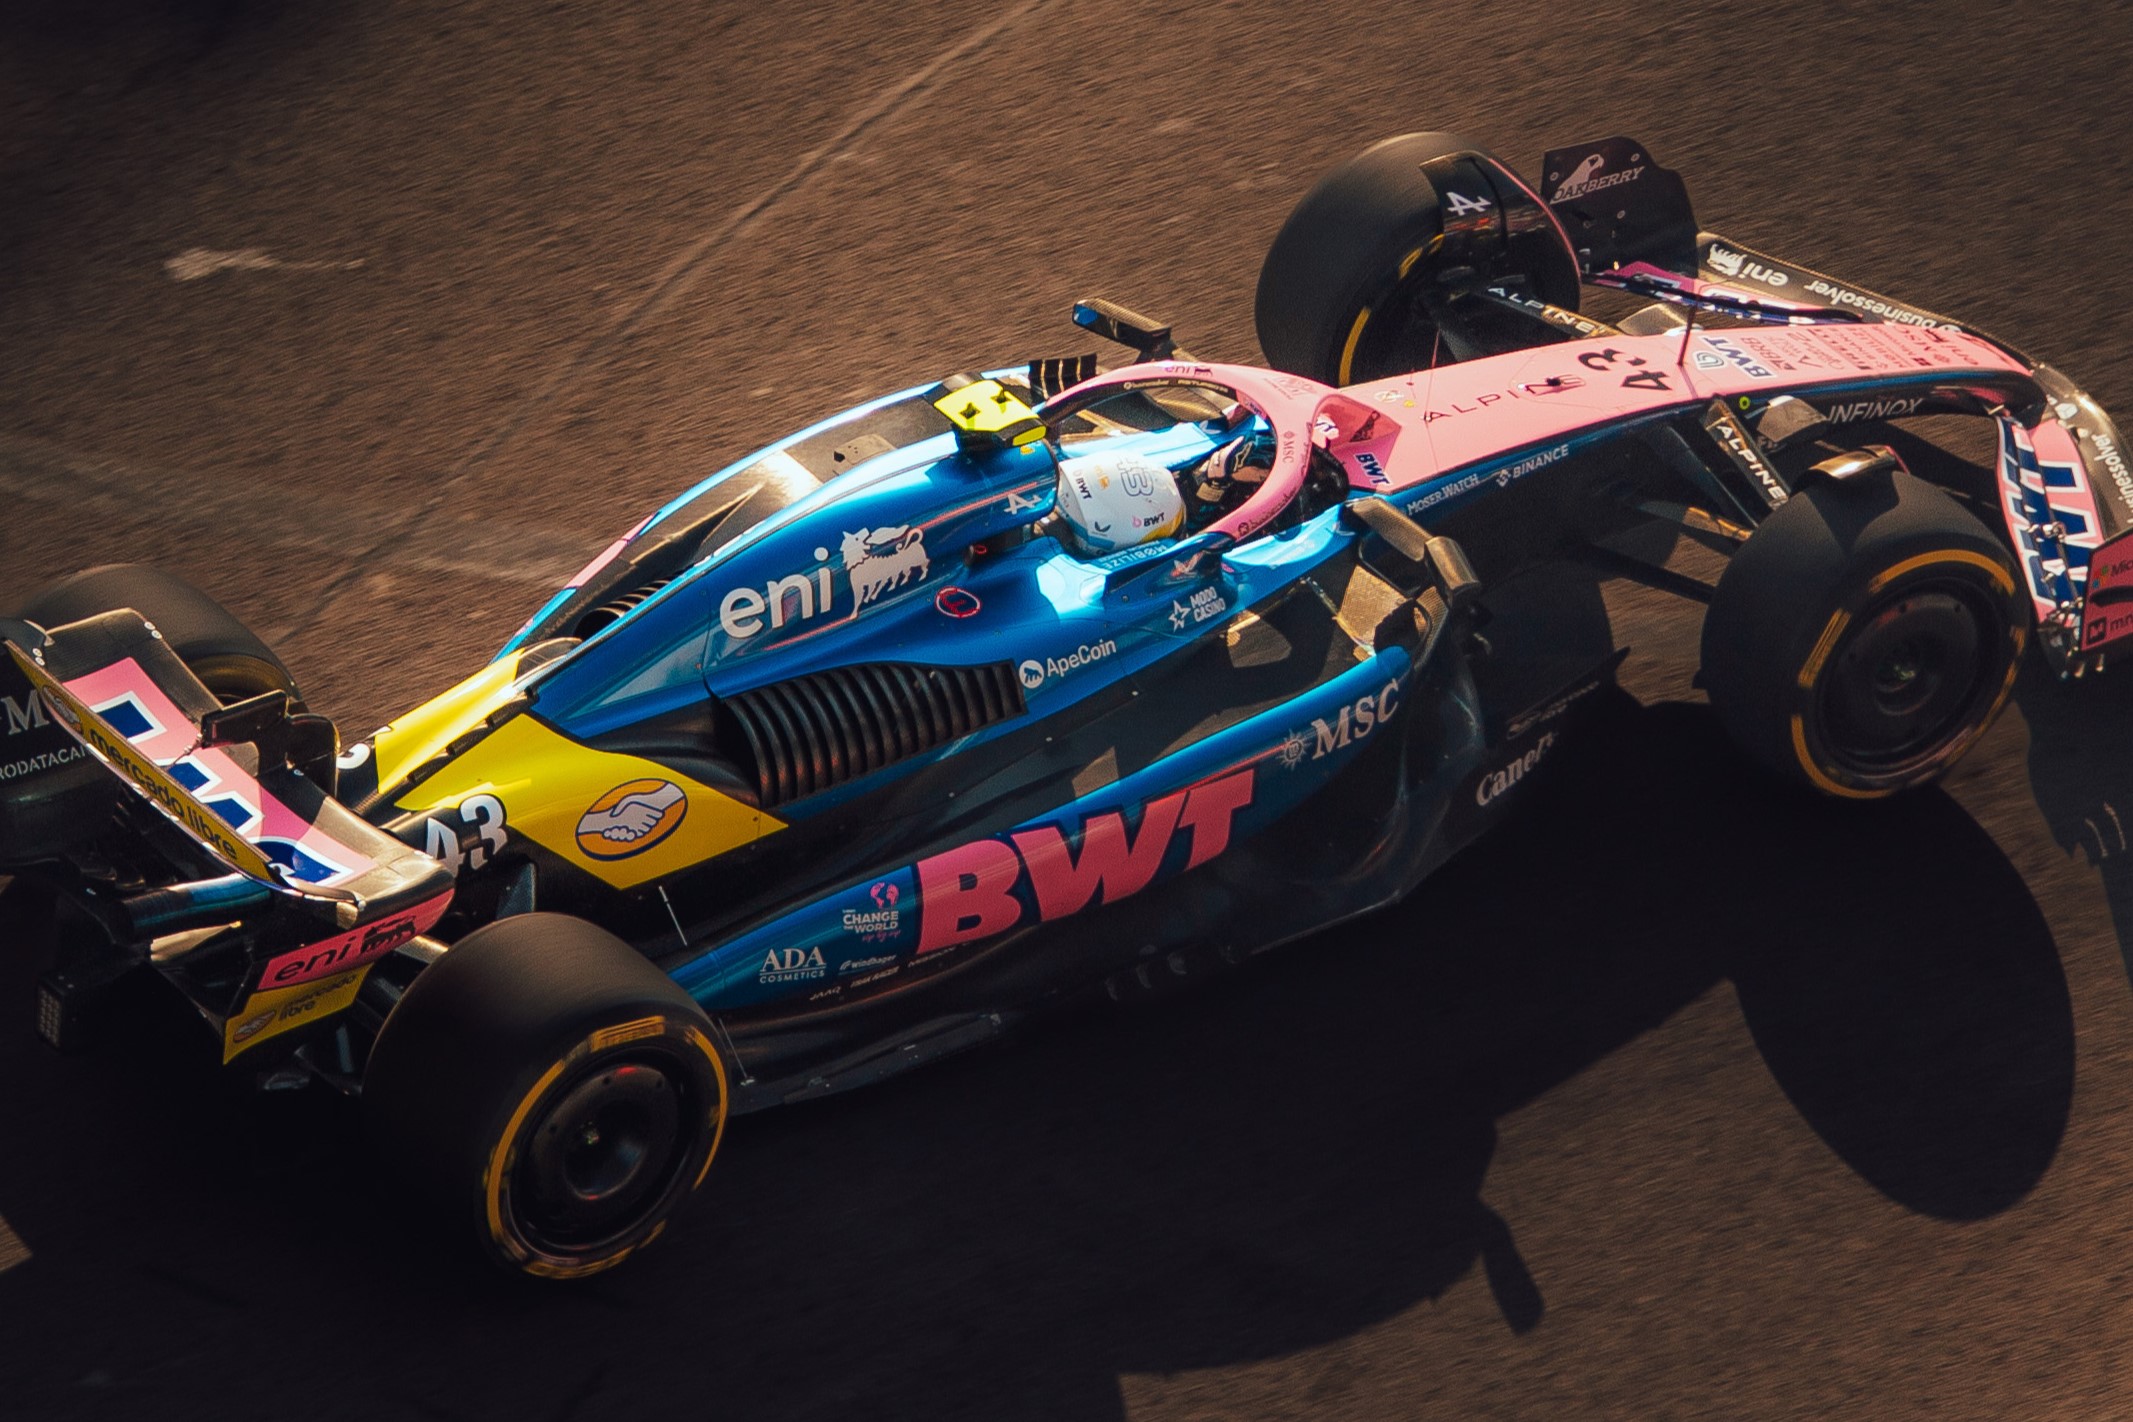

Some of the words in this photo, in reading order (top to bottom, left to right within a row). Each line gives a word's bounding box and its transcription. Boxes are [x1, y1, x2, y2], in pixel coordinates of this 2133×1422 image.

[1739, 261, 1790, 288] eni
[1488, 286, 1596, 334] ALPINE
[1702, 336, 1773, 378] BWT
[1827, 397, 1924, 425] INFINOX
[1282, 440, 1295, 464] MSC
[1355, 452, 1391, 486] BWT
[1513, 443, 1570, 479] BINANCE
[1716, 424, 1788, 501] ALPINE
[1143, 511, 1166, 528] BWT
[719, 547, 834, 640] eni
[1189, 586, 1218, 610] MODO
[1193, 597, 1227, 623] CASINO
[1046, 638, 1118, 678] ApeCoin
[1310, 677, 1400, 762] MSC
[90, 728, 185, 817] mercado
[187, 805, 238, 860] libre
[424, 793, 509, 878] 43
[916, 769, 1255, 954] BWT
[842, 910, 899, 926] CHANGE
[854, 920, 899, 935] WORLD
[274, 935, 358, 982] eni
[760, 945, 827, 973] ADA
[759, 969, 826, 985] COSMETICS
